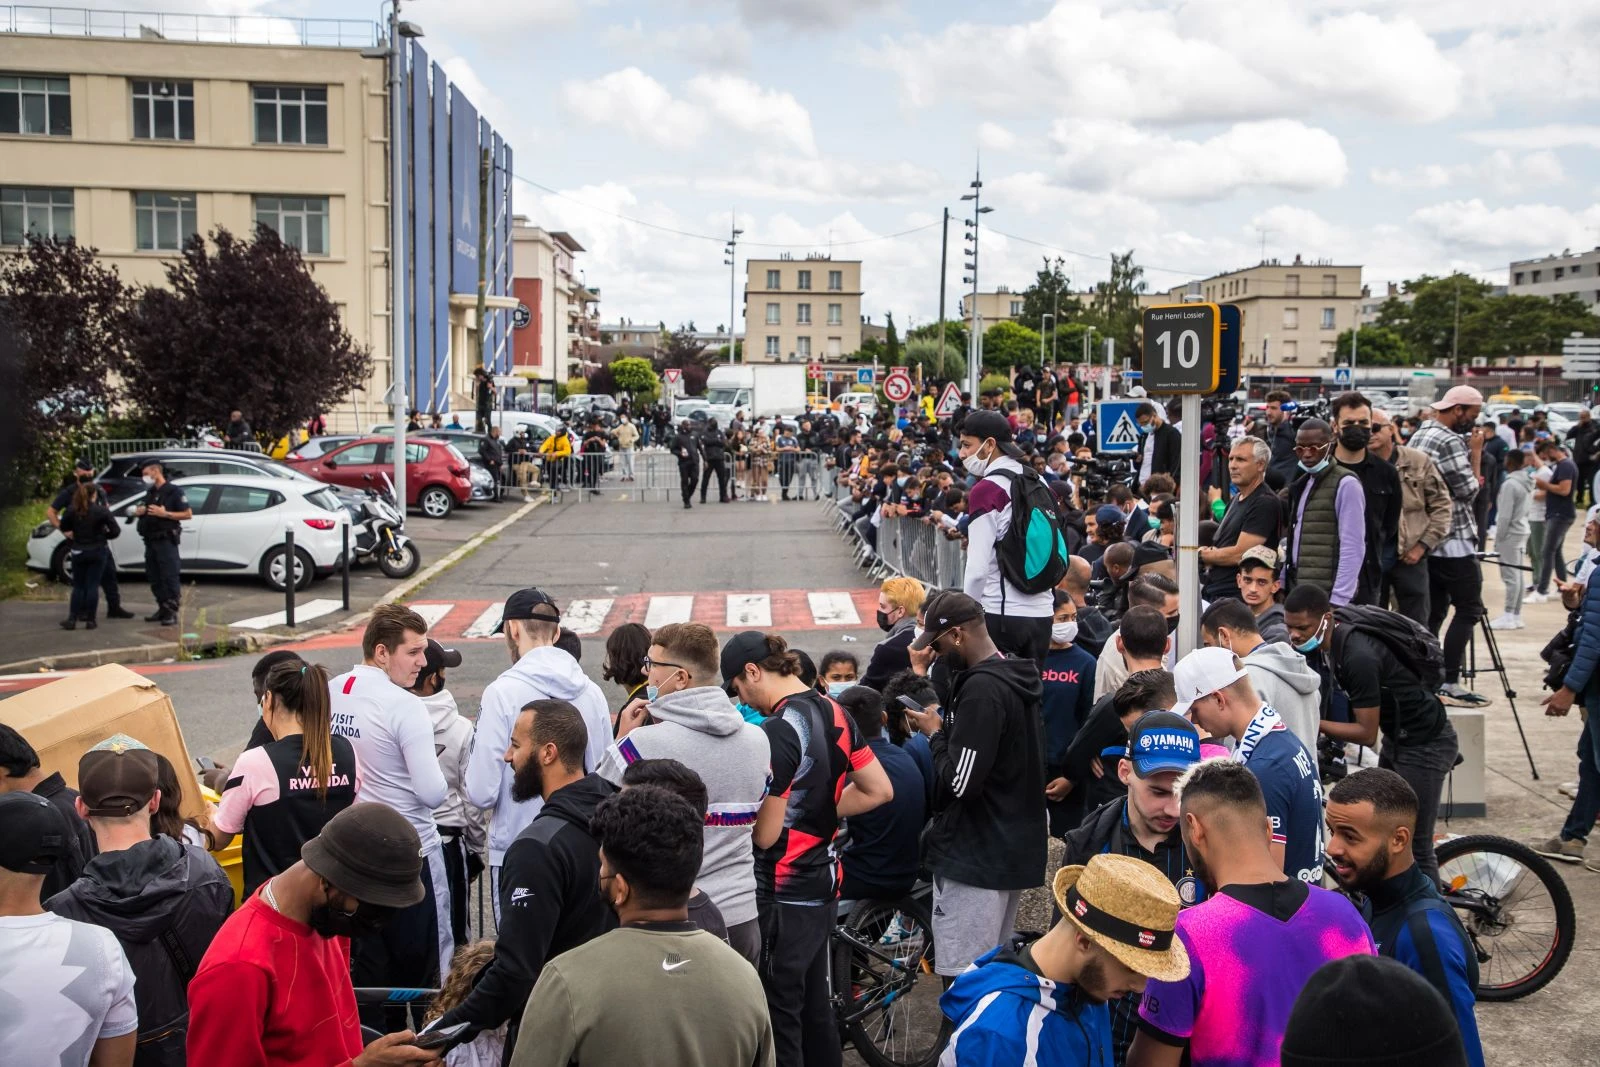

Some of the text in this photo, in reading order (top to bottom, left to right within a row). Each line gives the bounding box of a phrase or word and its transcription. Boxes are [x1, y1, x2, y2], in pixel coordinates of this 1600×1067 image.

[1165, 312, 1182, 320] Henri
[1183, 311, 1205, 319] Lossier
[1155, 329, 1200, 369] 10
[1041, 669, 1079, 684] ebok
[330, 724, 361, 739] ANDA
[1151, 733, 1194, 751] YAMAHA
[301, 763, 337, 778] VT
